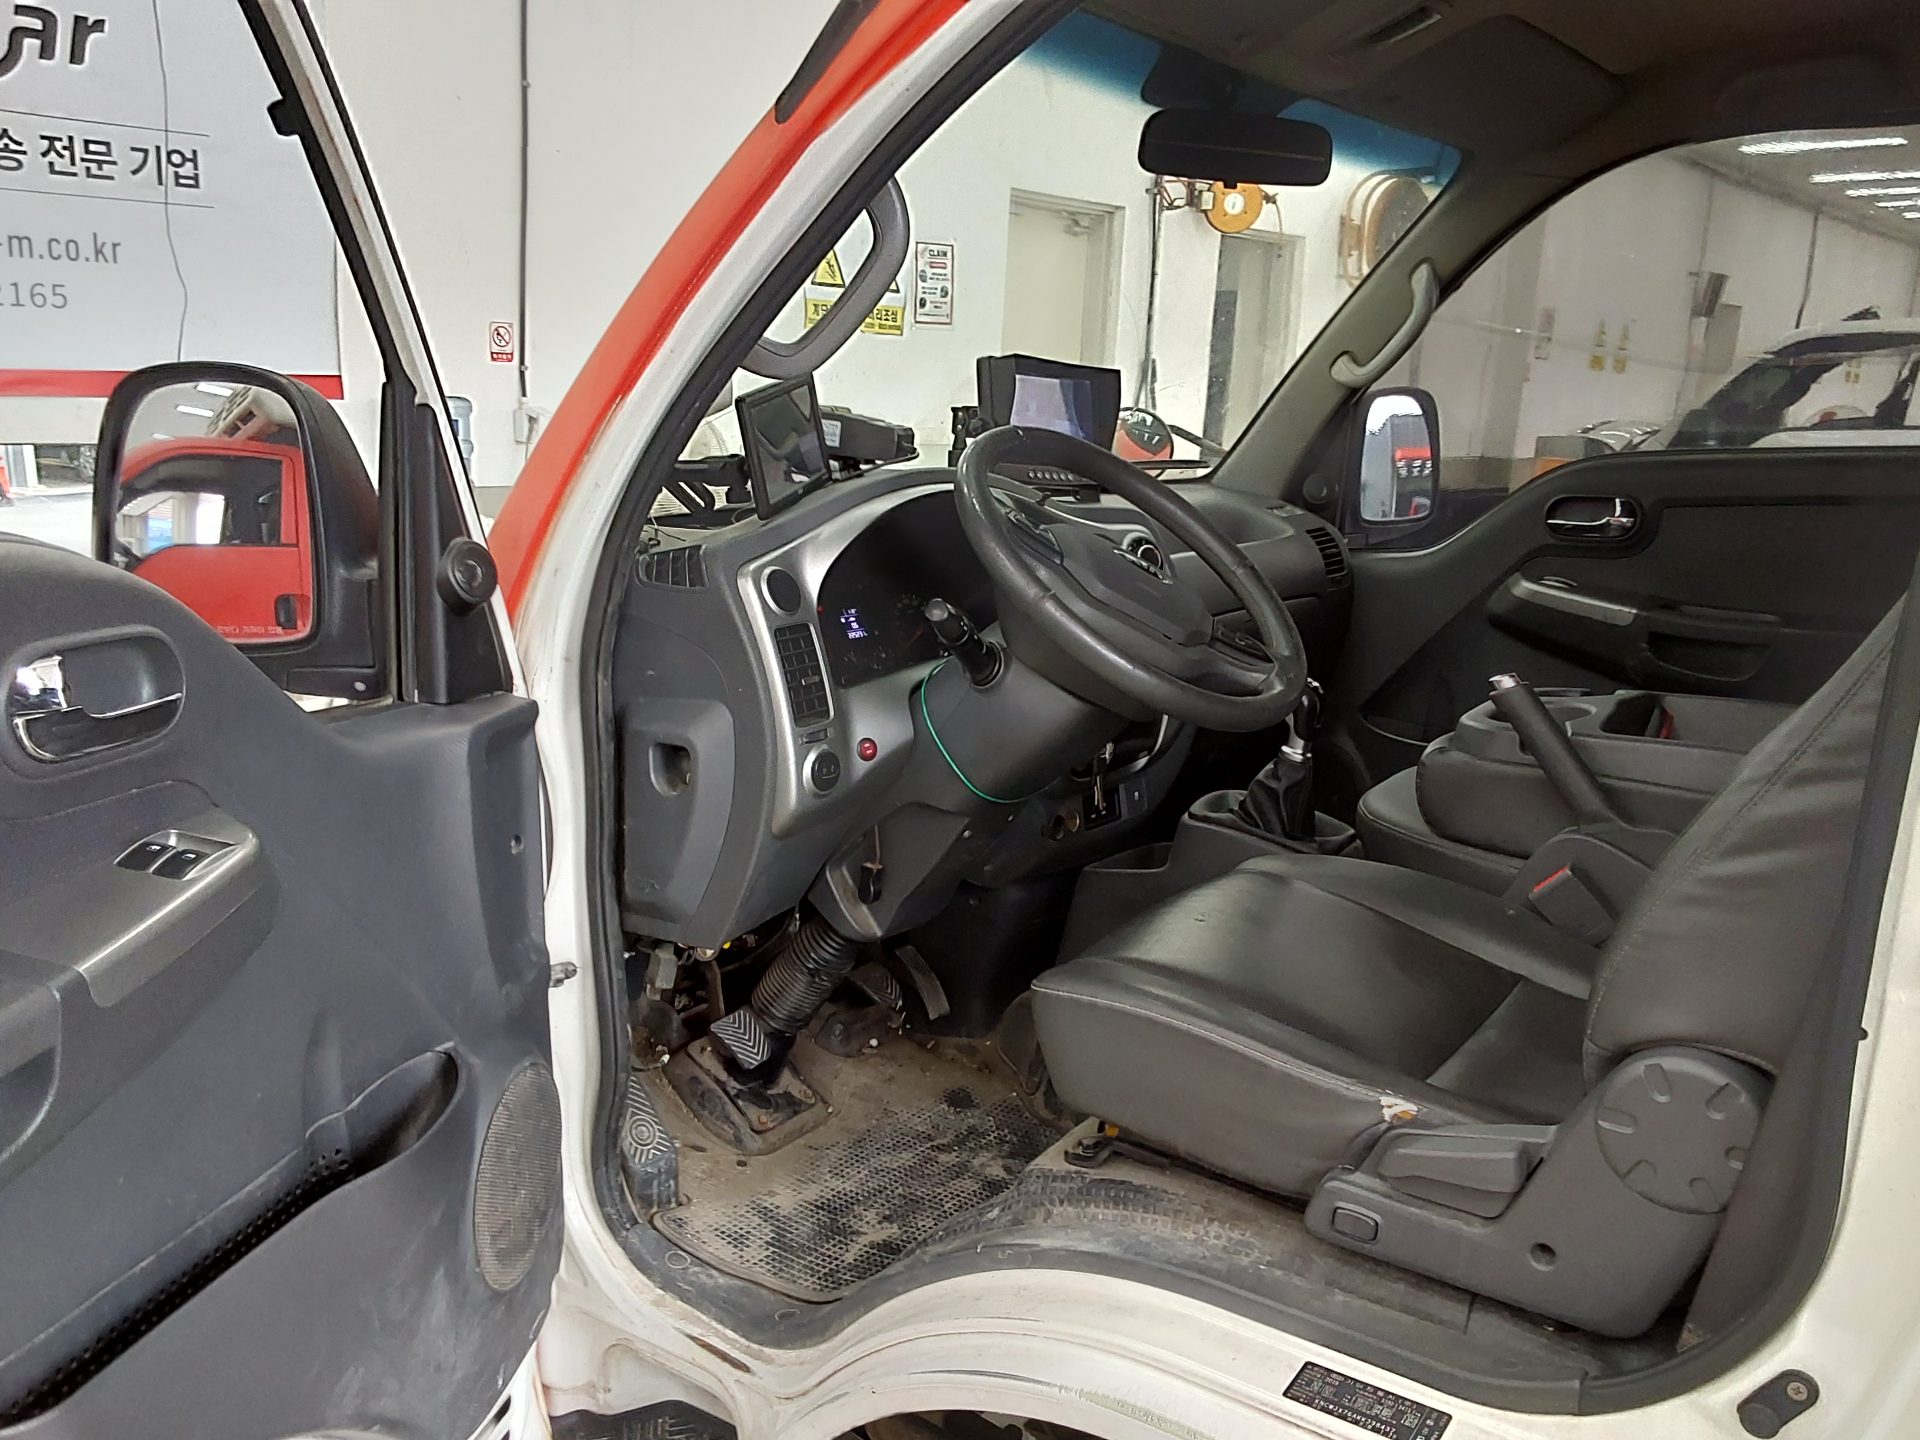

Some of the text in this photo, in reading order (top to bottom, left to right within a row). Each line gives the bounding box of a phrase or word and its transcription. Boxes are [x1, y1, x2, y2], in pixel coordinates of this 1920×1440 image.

[38, 134, 118, 181] 전문
[129, 145, 201, 189] 기업
[0, 281, 68, 310] 165
